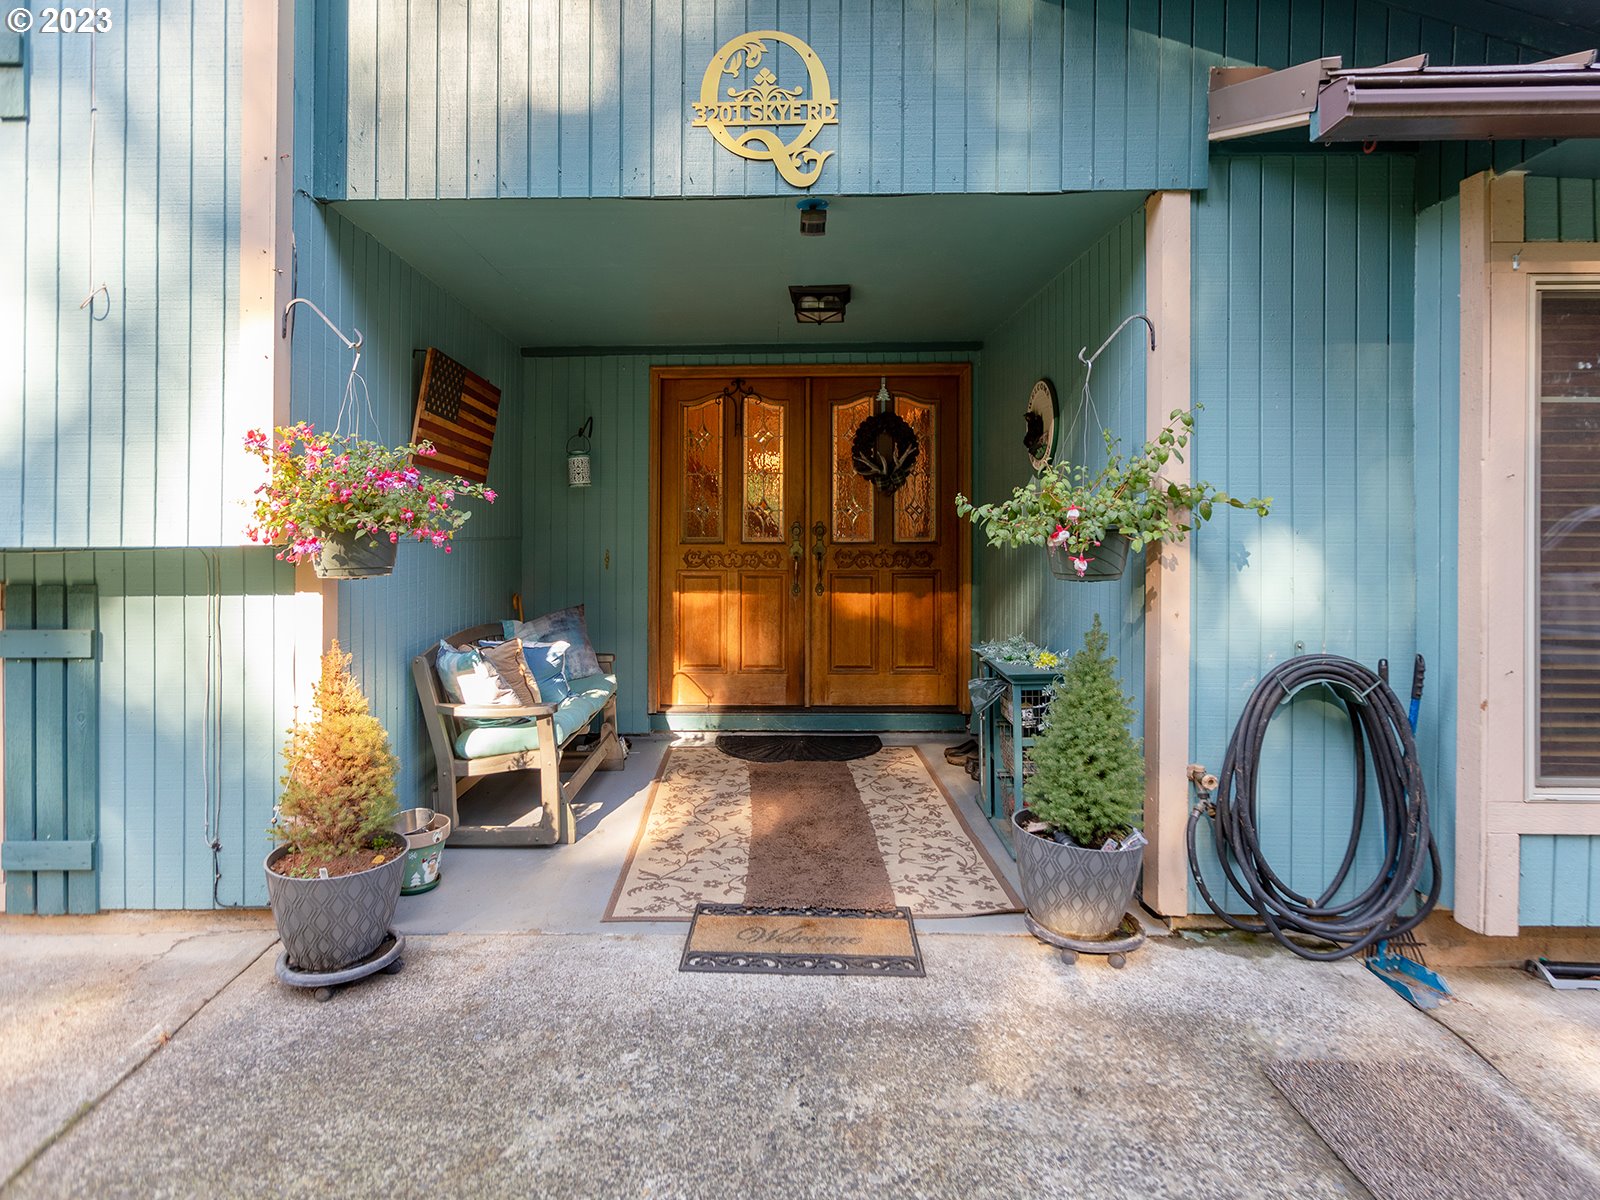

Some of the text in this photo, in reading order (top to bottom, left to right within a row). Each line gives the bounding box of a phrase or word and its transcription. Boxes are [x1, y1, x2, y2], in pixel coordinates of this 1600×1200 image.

[695, 103, 836, 122] 3201 SKYE RD
[701, 30, 834, 187] Q
[736, 925, 863, 945] Welcome
